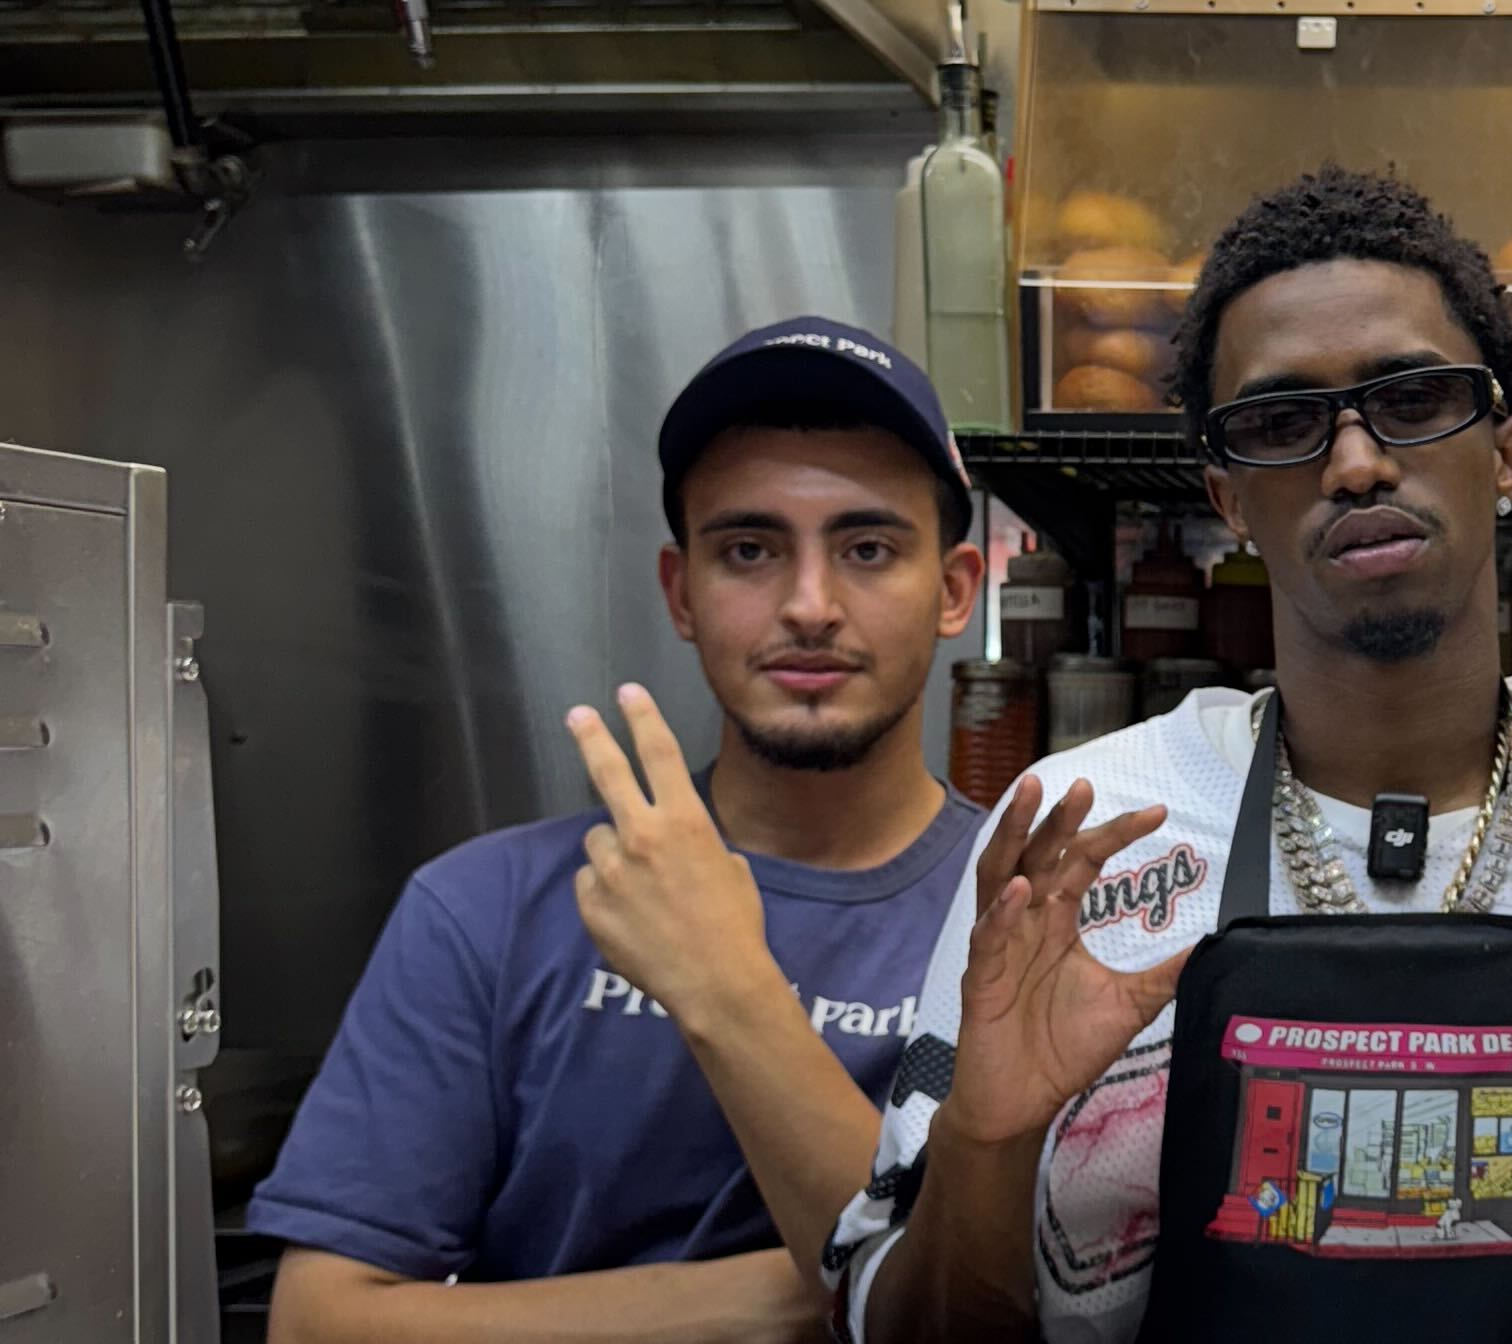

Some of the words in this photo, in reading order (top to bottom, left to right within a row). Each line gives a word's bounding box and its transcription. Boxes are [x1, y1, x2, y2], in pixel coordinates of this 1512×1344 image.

[836, 337, 892, 369] Park
[1268, 1026, 1403, 1053] PROSPECT
[1408, 1031, 1476, 1054] PARK
